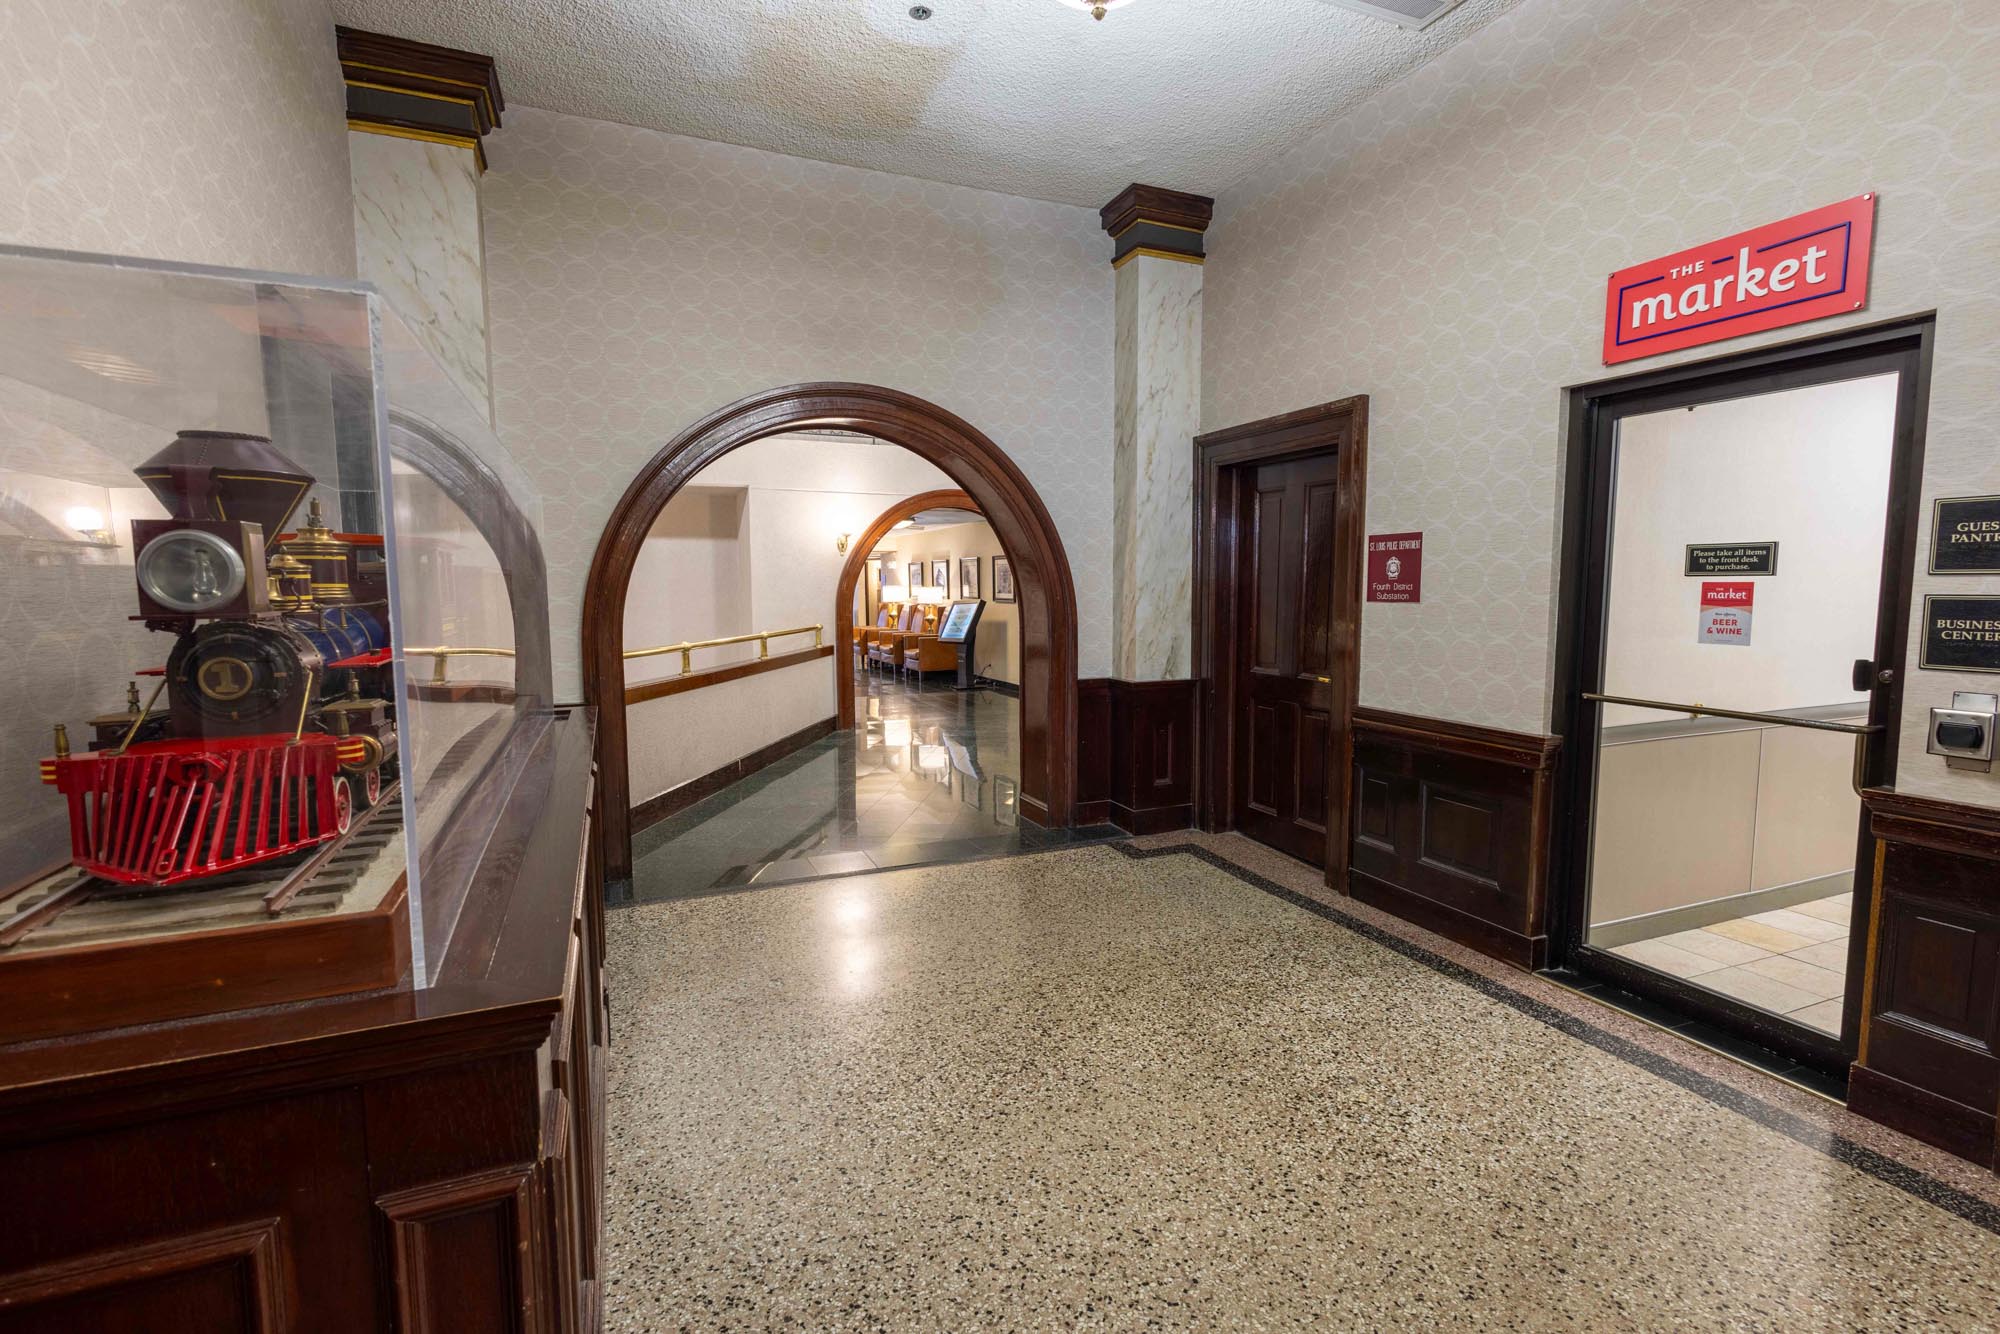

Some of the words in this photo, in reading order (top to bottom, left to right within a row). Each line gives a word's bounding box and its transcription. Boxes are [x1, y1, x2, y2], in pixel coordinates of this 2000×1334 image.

[1670, 260, 1705, 280] THE
[1632, 246, 1828, 329] market
[1386, 541, 1398, 550] POLICE
[1398, 540, 1421, 550] DEPARTMENT
[1693, 549, 1716, 557] Please
[1734, 548, 1744, 556] all
[1745, 548, 1767, 556] items
[1714, 563, 1751, 572] purchase.
[1372, 582, 1391, 591] Fourth
[1393, 582, 1413, 591] District
[1376, 592, 1409, 600] Substation
[1707, 587, 1747, 600] market
[1712, 618, 1738, 626] BEER
[1706, 626, 1714, 634] &
[1716, 627, 1743, 635] WINE
[210, 662, 240, 693] 1
